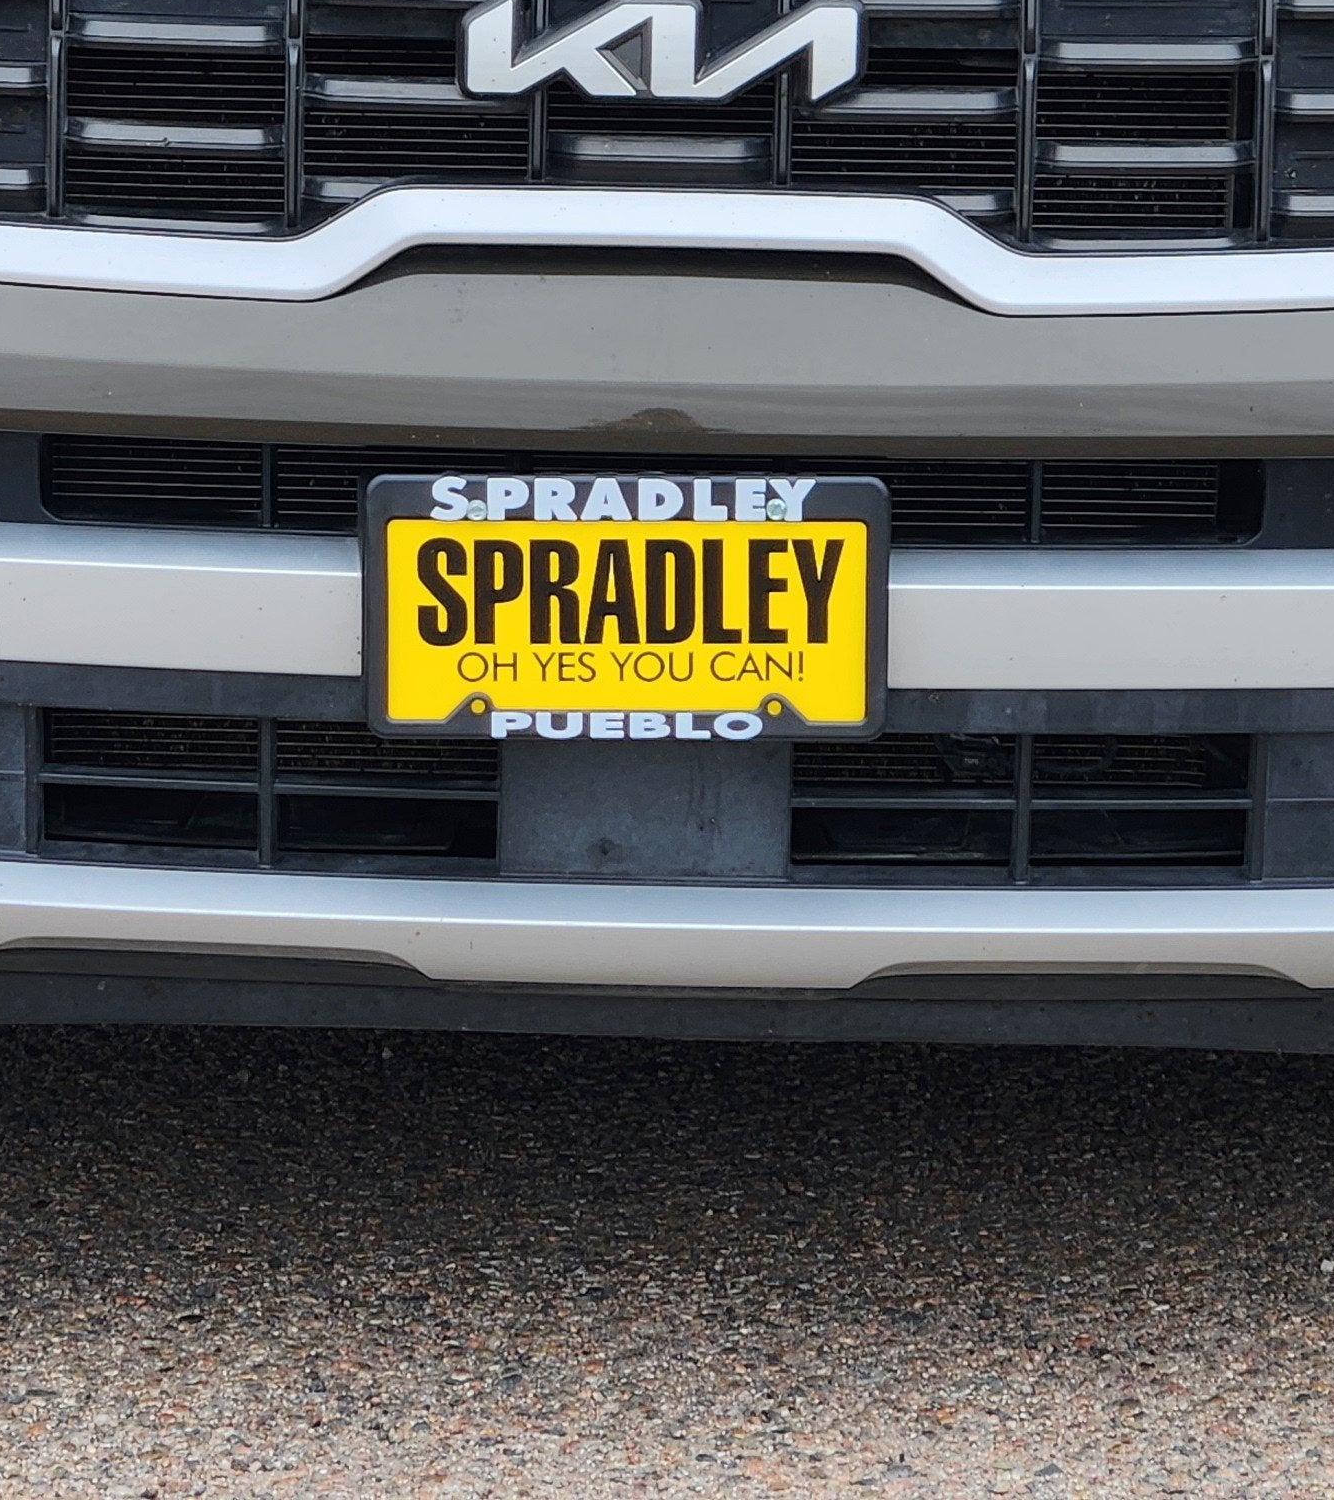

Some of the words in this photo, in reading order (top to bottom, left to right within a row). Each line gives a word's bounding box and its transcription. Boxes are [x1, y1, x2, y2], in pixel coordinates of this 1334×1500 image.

[430, 475, 817, 522] SPRADLEY
[417, 537, 845, 646] SPRADLEY
[457, 651, 518, 683] OH
[533, 651, 597, 683] YES
[610, 651, 694, 683] YOU
[709, 651, 805, 683] CAN!
[491, 711, 764, 741] PUEBLO
